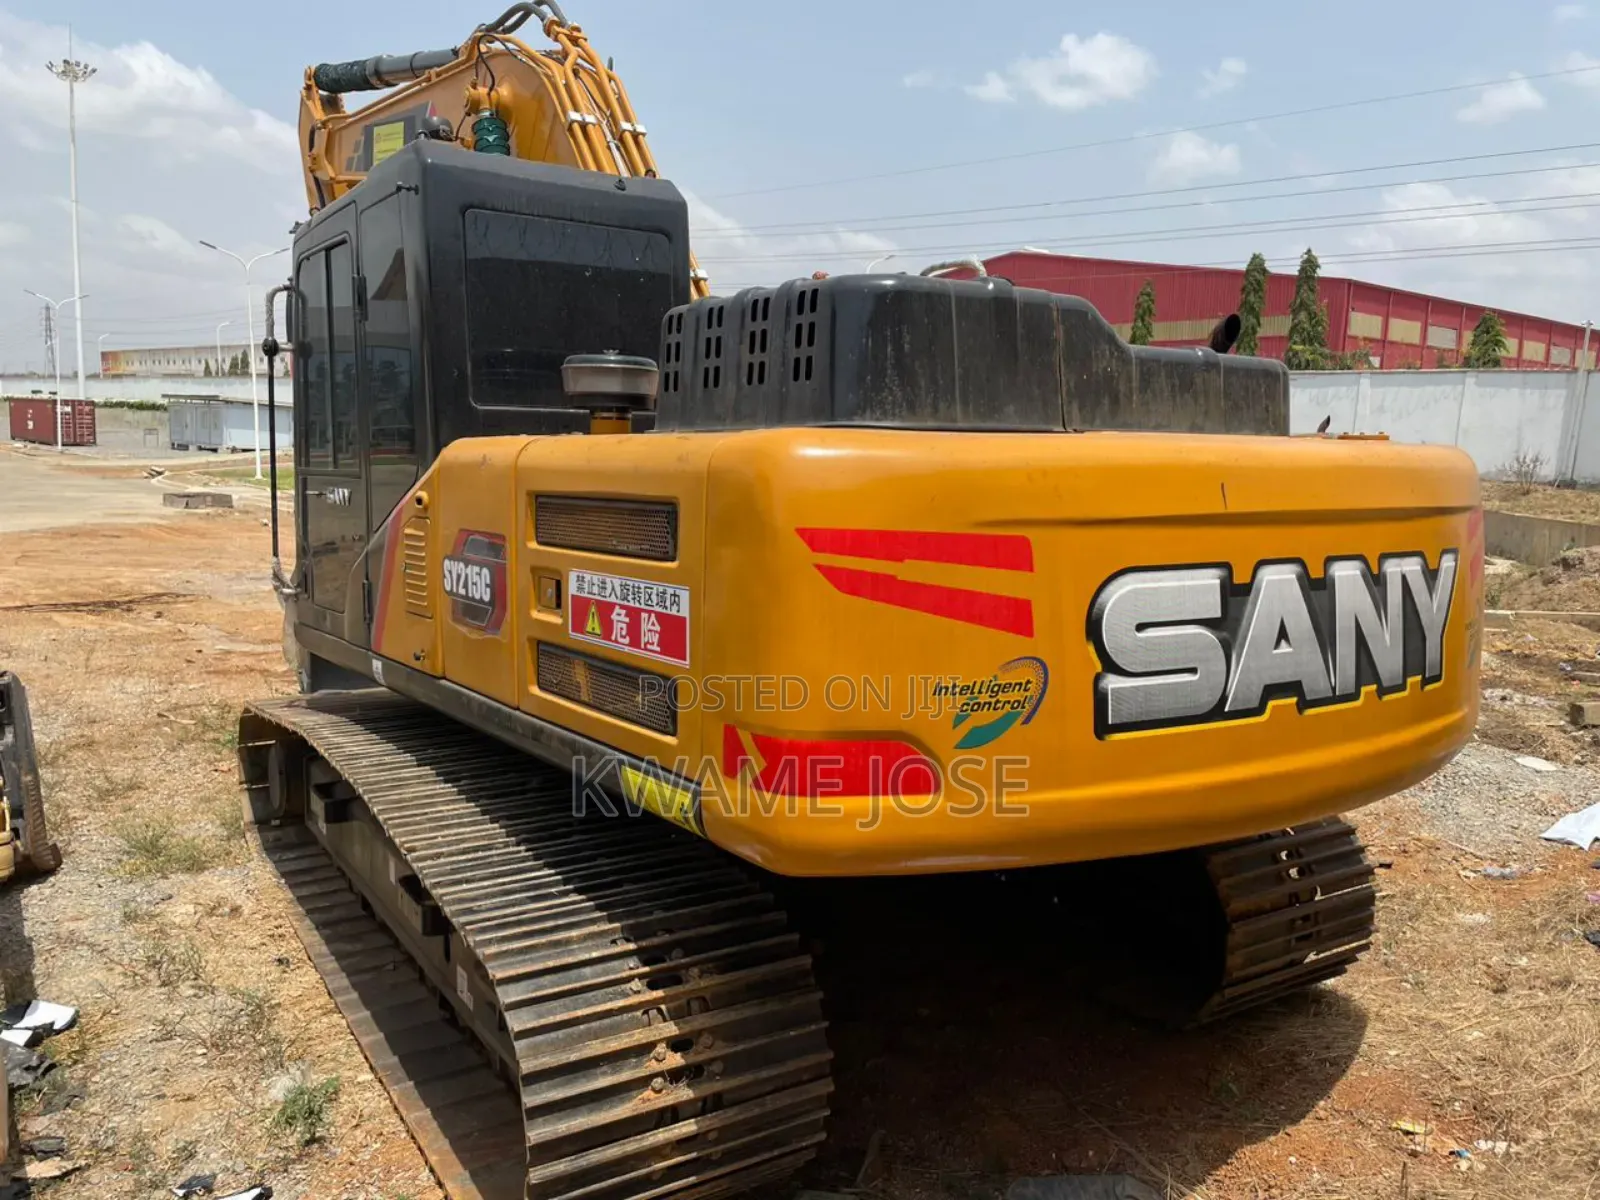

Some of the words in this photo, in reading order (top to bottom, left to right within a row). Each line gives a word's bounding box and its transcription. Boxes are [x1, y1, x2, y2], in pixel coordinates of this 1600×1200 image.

[443, 558, 491, 602] SY215C
[575, 574, 681, 613] 禁止进入旋转区域内
[610, 605, 661, 652] 危险
[1090, 551, 1457, 732] SANY
[959, 695, 1029, 714] control
